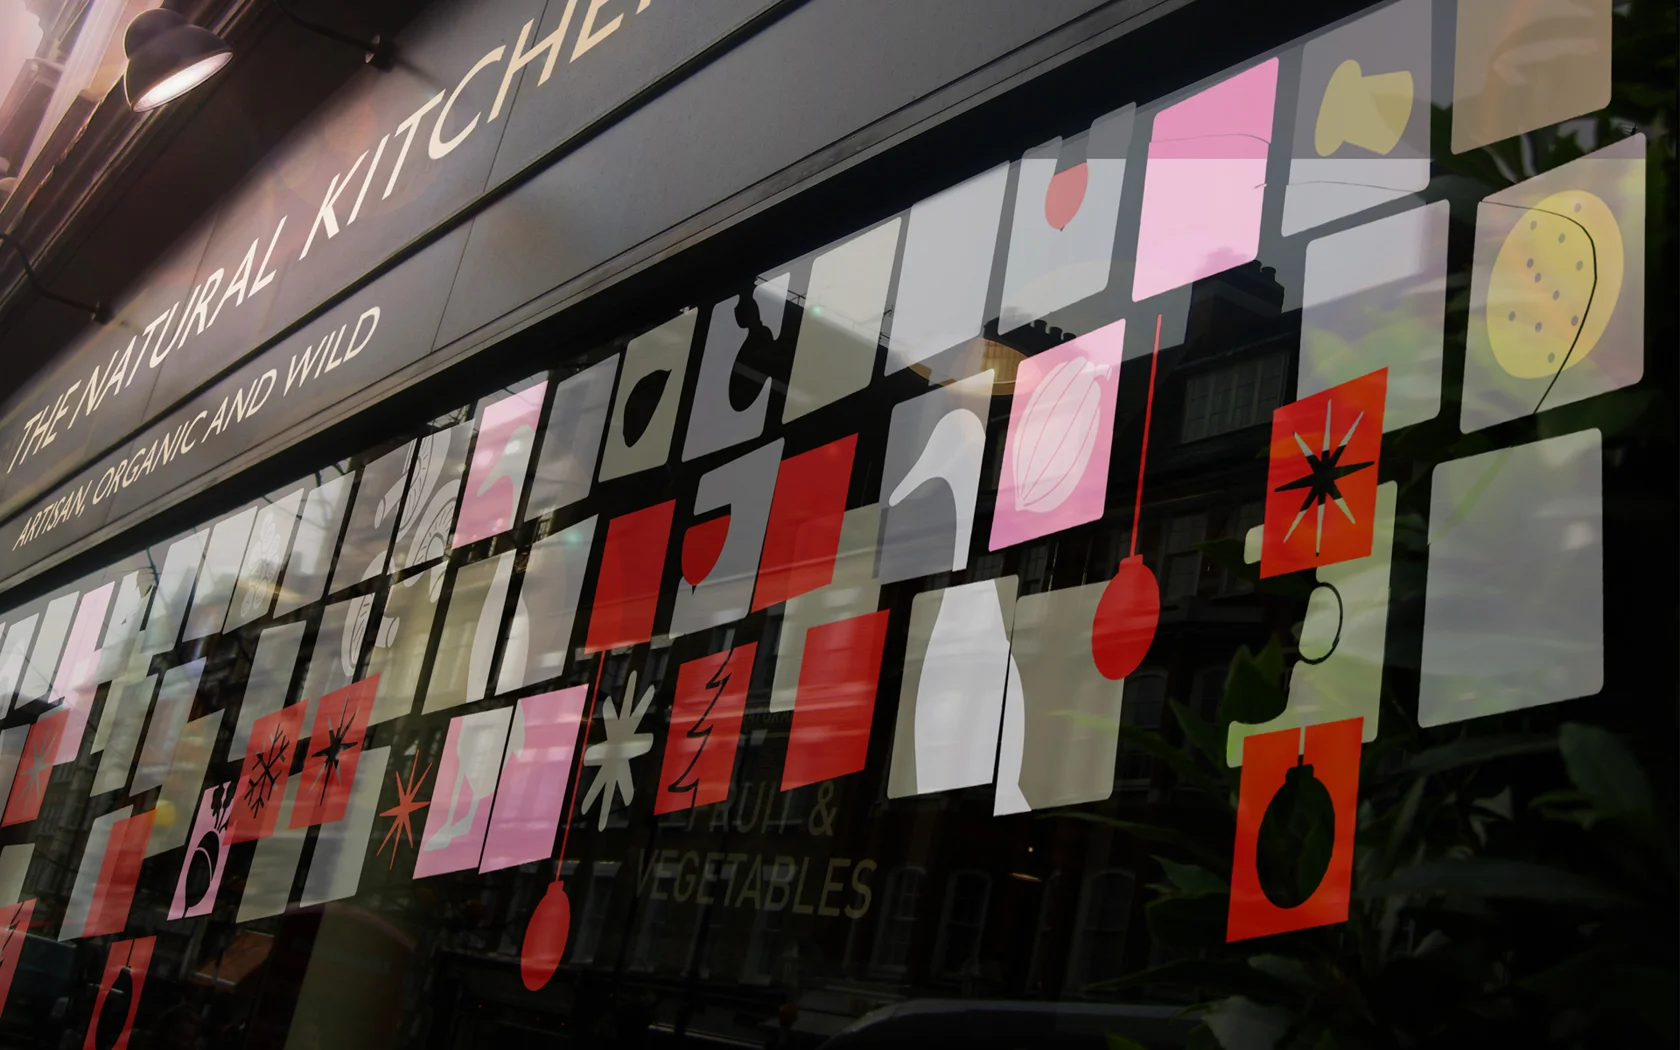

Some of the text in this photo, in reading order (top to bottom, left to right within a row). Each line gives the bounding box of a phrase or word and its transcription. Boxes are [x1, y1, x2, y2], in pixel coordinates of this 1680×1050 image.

[7, 0, 651, 474] THE NATURAL KITCHE
[12, 305, 381, 552] ARTISAN, ORGANIC AND WILD
[635, 847, 878, 919] VEGETABLES
[807, 779, 839, 836] &
